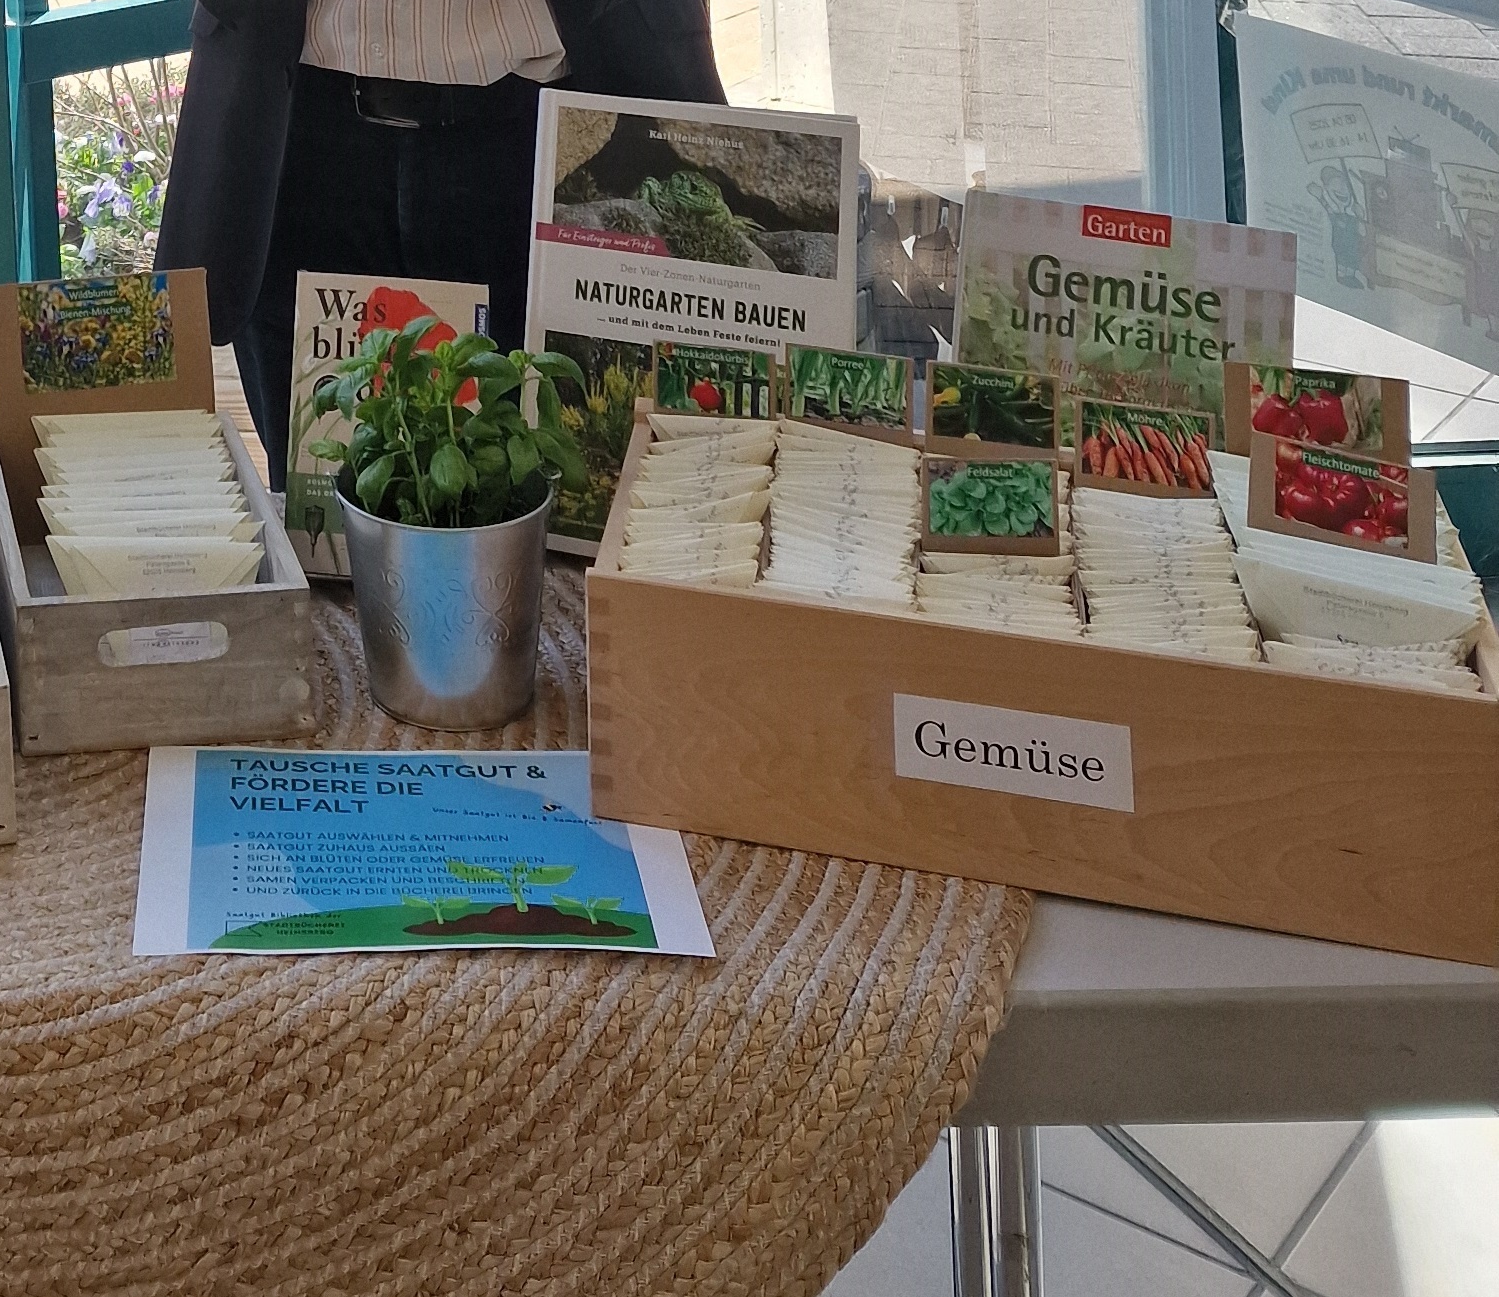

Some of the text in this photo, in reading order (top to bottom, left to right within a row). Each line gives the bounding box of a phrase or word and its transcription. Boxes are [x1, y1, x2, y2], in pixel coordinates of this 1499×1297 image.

[1086, 213, 1168, 245] Garten
[620, 262, 638, 275] Der
[67, 288, 120, 301] Wildblumen
[1027, 253, 1223, 325] Gemüse
[59, 305, 132, 320] Bienen-Mischung
[314, 287, 388, 324] Was
[574, 277, 807, 333] NATURGARTEN BAUEN
[608, 314, 629, 327] und
[631, 317, 650, 330] mit
[651, 320, 675, 333] dem
[677, 324, 711, 338] Leben
[712, 328, 742, 342] Feste
[1009, 306, 1237, 362] und Kräuter
[830, 356, 865, 371] Porree
[971, 375, 1015, 390] Zucchini
[1295, 375, 1336, 390] Paprika
[1126, 411, 1164, 426] Möhre
[967, 466, 1014, 479] Feldsalat
[1302, 452, 1381, 478] Fleischtomate
[913, 720, 1106, 783] Gemüse
[229, 758, 548, 780] TAUSCHE SAATGUT &
[230, 773, 425, 797] FÖRDERE DIE
[229, 795, 371, 815] VIELFALT
[246, 831, 313, 841] SAATGUT
[316, 830, 406, 842] AUSWÄHLEN
[424, 833, 510, 844] MITNEHMEN
[246, 842, 313, 852] SAATGUT
[246, 853, 282, 863] SICH
[285, 854, 307, 863] AN
[309, 852, 363, 864] BLÜTEN
[366, 854, 407, 864] ODER
[246, 864, 293, 874] NEUES
[295, 865, 365, 875] SAATGUT
[366, 865, 424, 875] ERNTEN
[246, 874, 298, 885] SAMEN
[300, 875, 388, 885] VERPACKEN
[390, 875, 425, 885] UND
[246, 885, 279, 896] UND
[282, 884, 342, 896] ZURÜCK
[345, 886, 361, 897] IN
[364, 886, 387, 897] DIE
